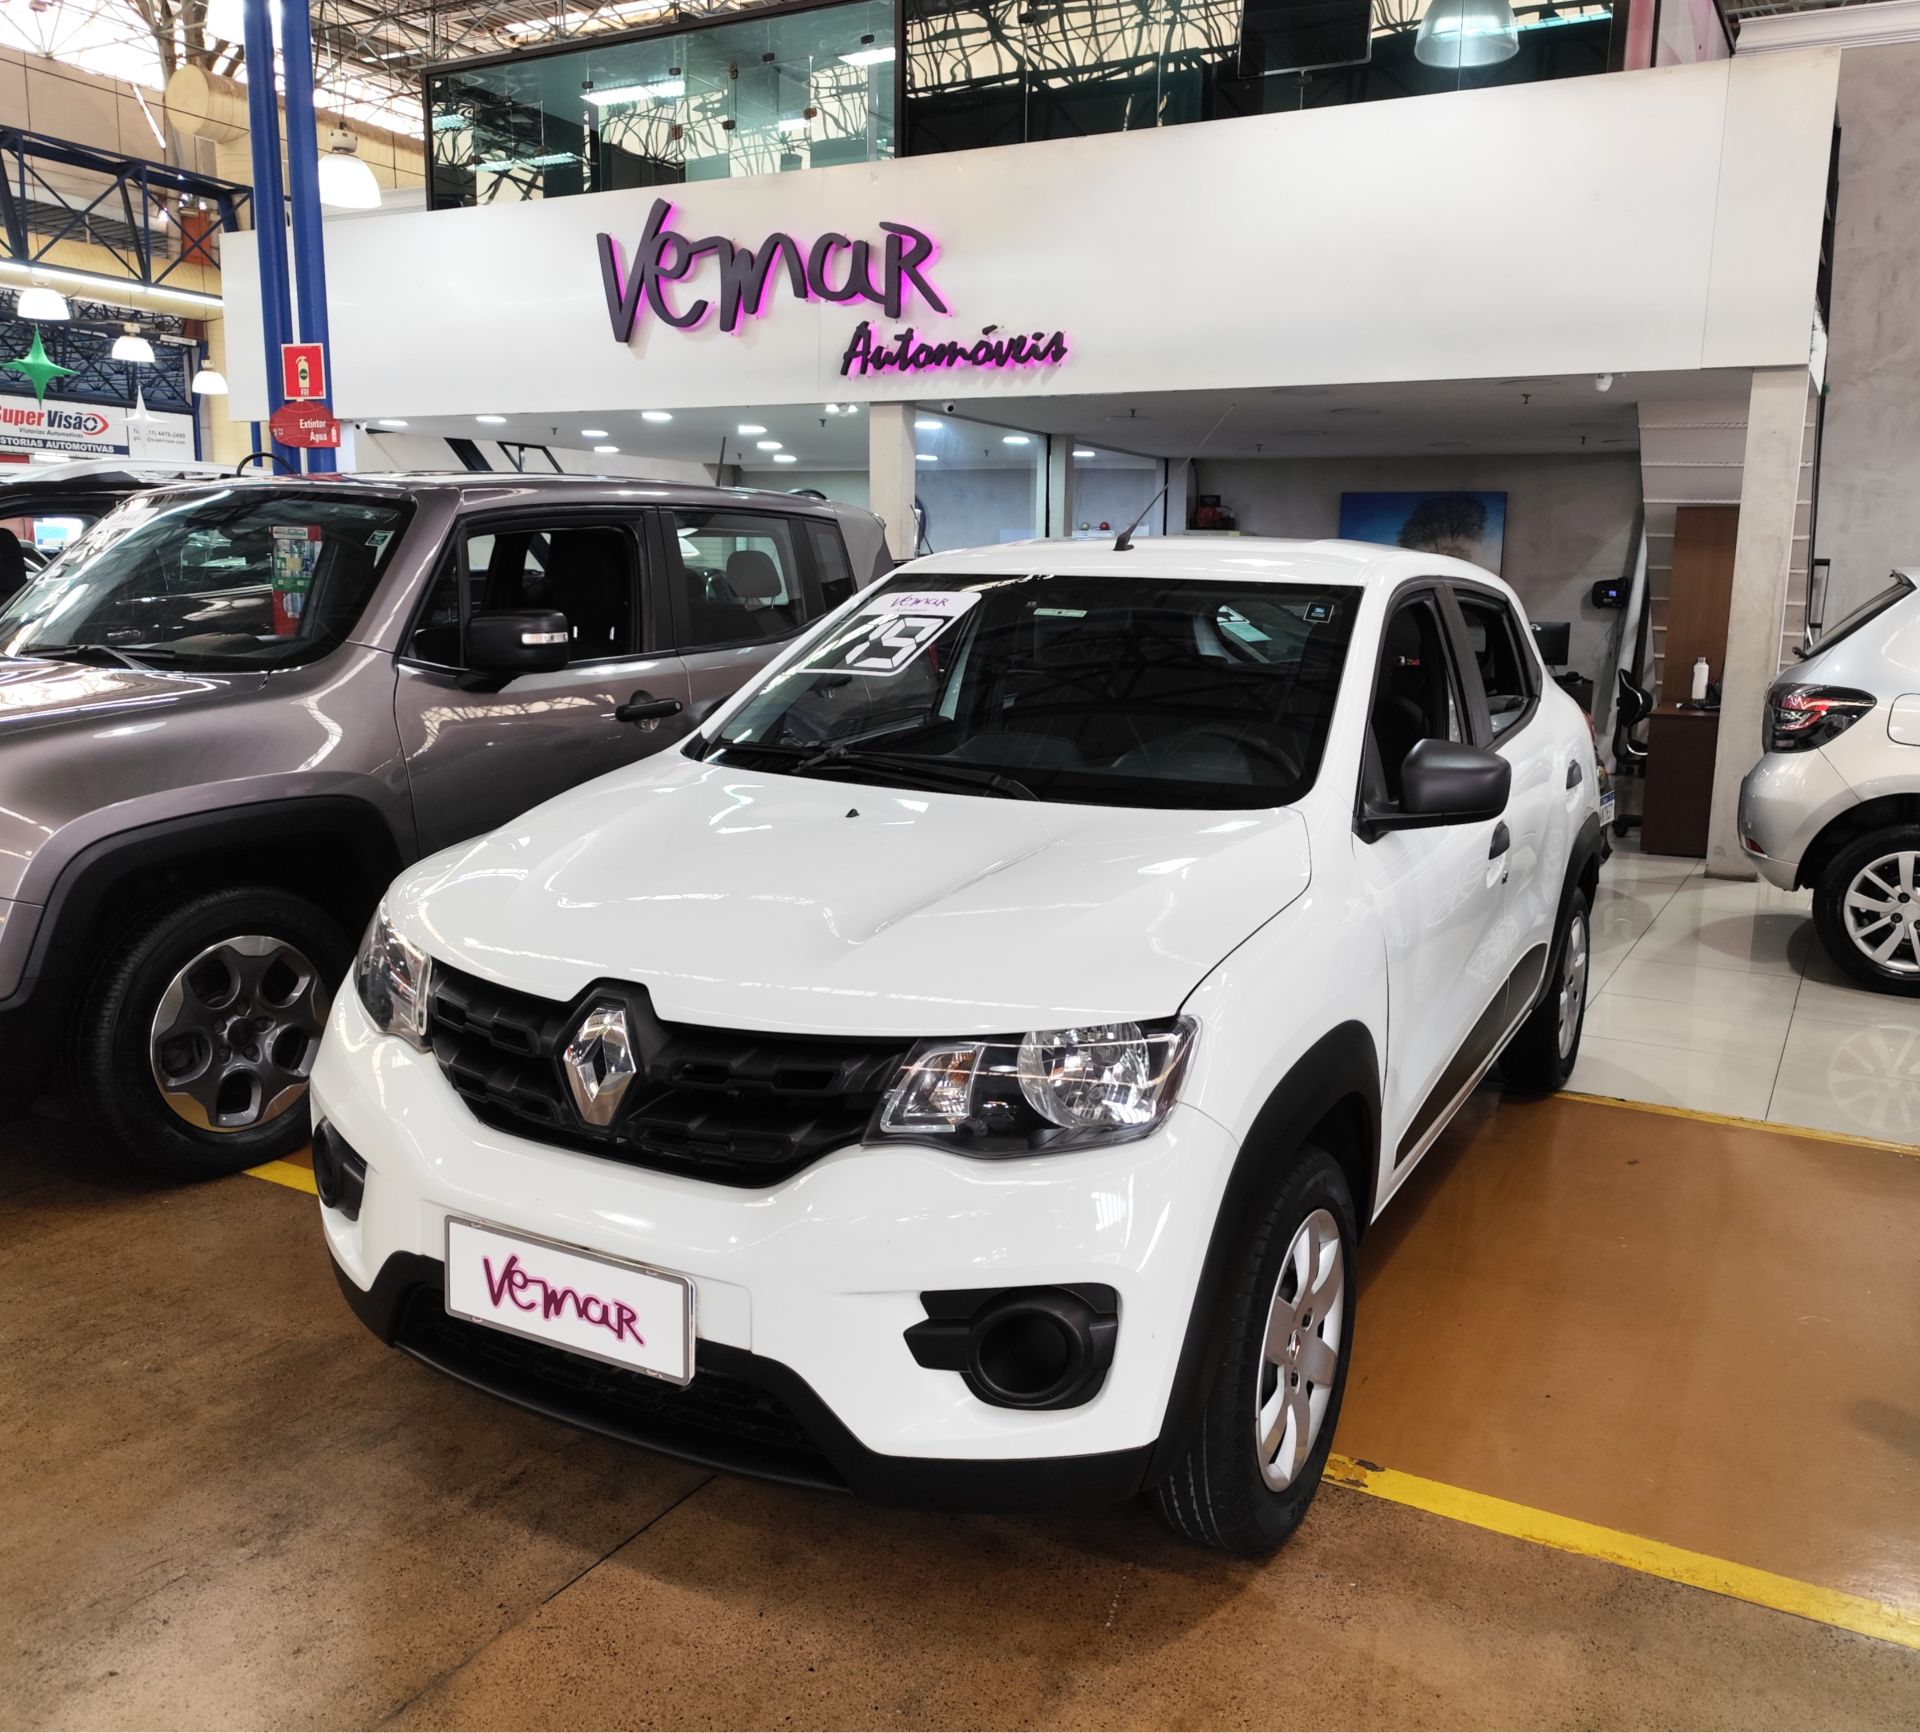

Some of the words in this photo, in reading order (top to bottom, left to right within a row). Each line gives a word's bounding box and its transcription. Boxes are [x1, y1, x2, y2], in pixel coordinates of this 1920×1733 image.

[841, 320, 1068, 376] Automóveis
[299, 418, 326, 429] Extintor
[310, 428, 328, 443] Água
[46, 441, 115, 453] AUTOMOTIVAS
